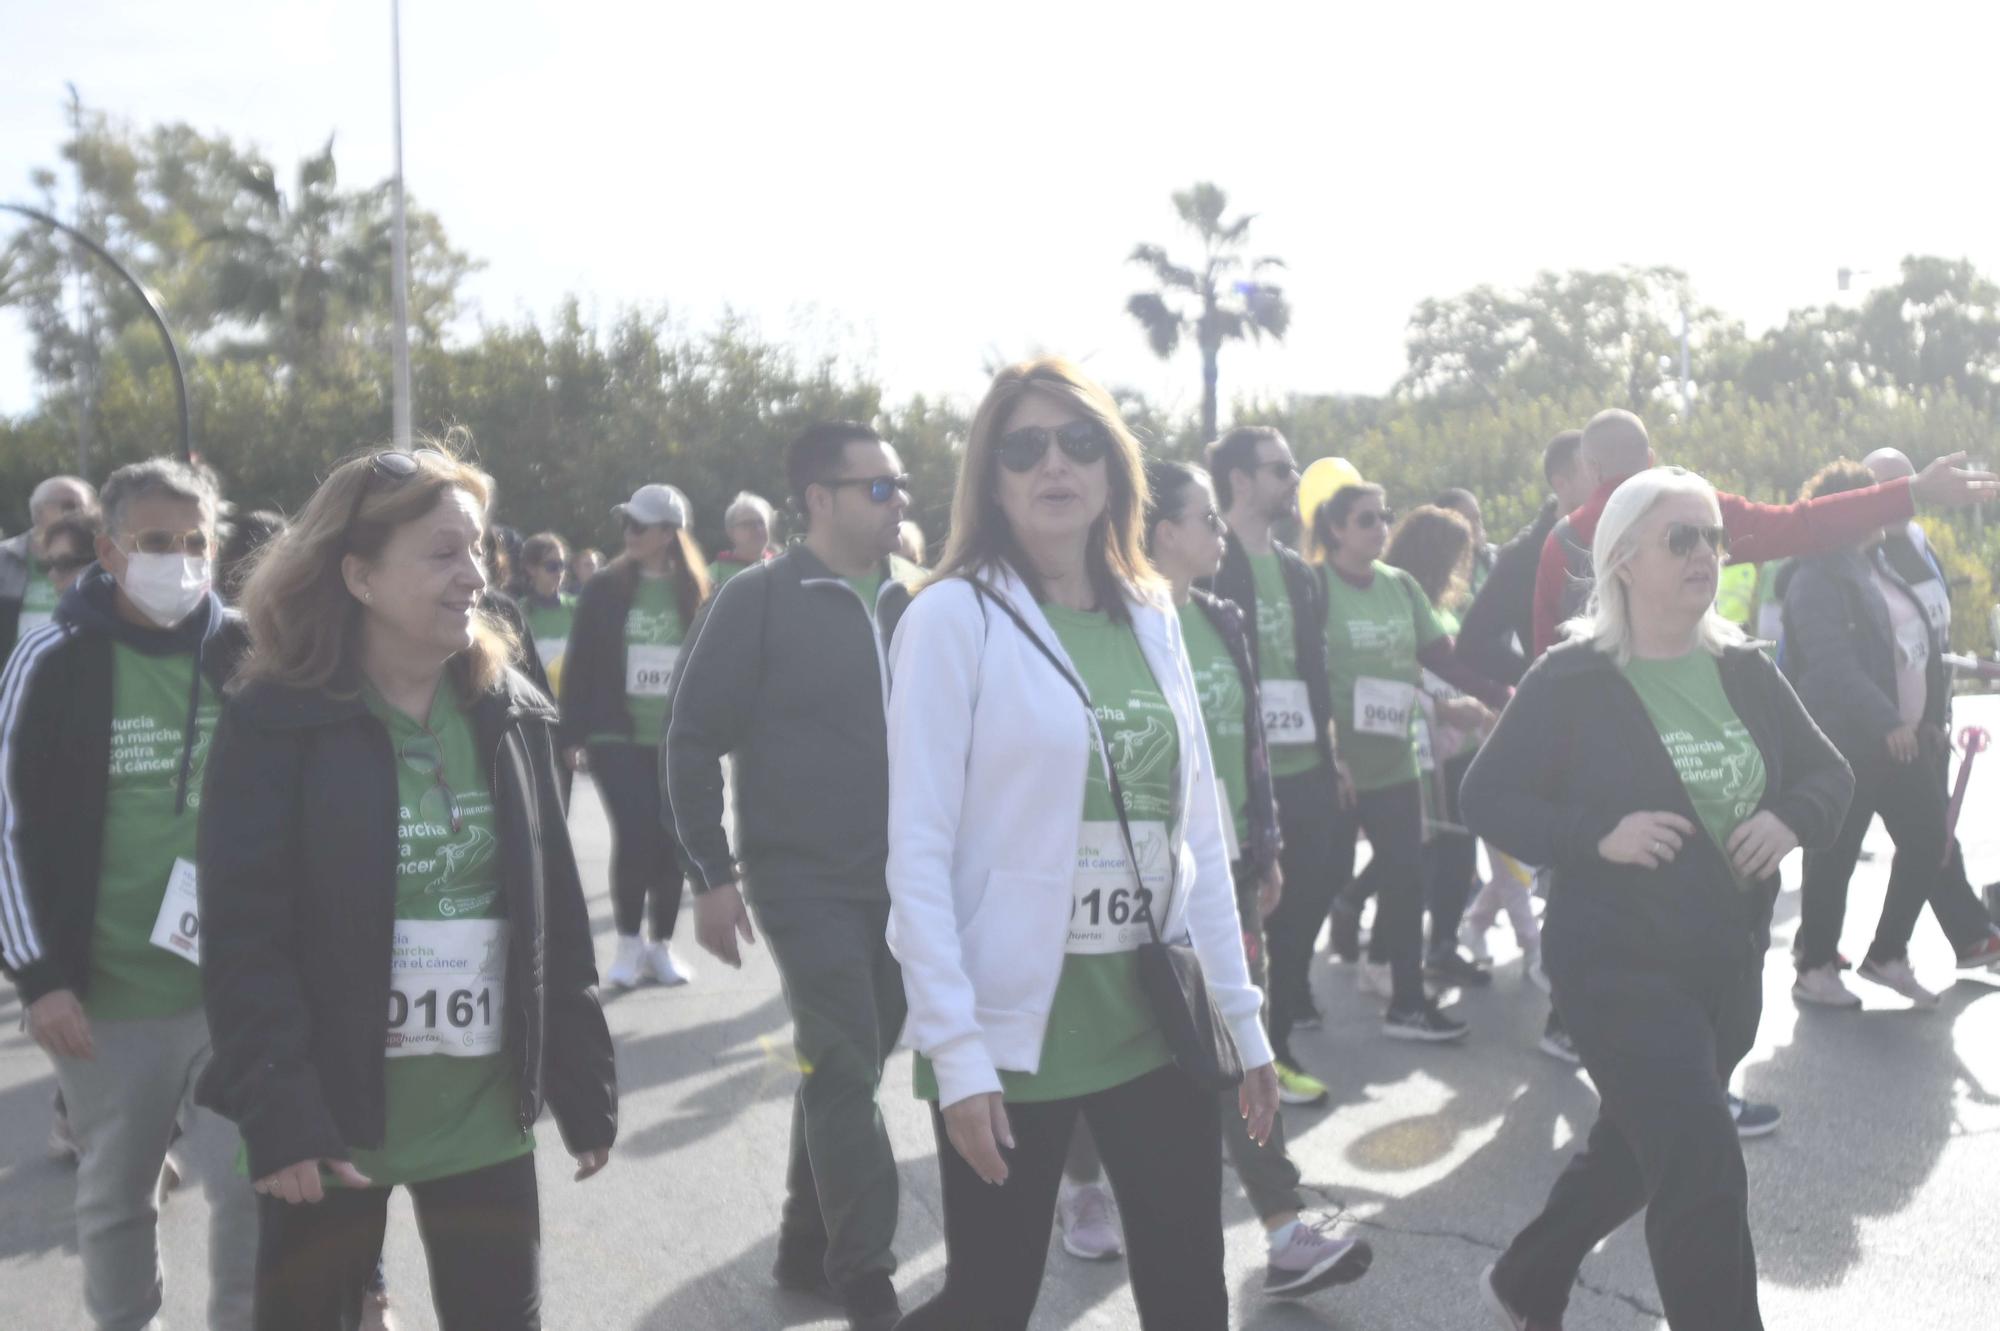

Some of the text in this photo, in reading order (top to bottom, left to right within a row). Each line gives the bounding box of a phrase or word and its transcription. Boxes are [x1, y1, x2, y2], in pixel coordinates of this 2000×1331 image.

[128, 728, 182, 744] marcha
[112, 746, 154, 760] ontra
[1675, 740, 1726, 755] marcha
[125, 758, 176, 773] cáncer
[1070, 887, 1153, 926] 162
[426, 956, 469, 969] cáncer
[386, 987, 491, 1029] 0161
